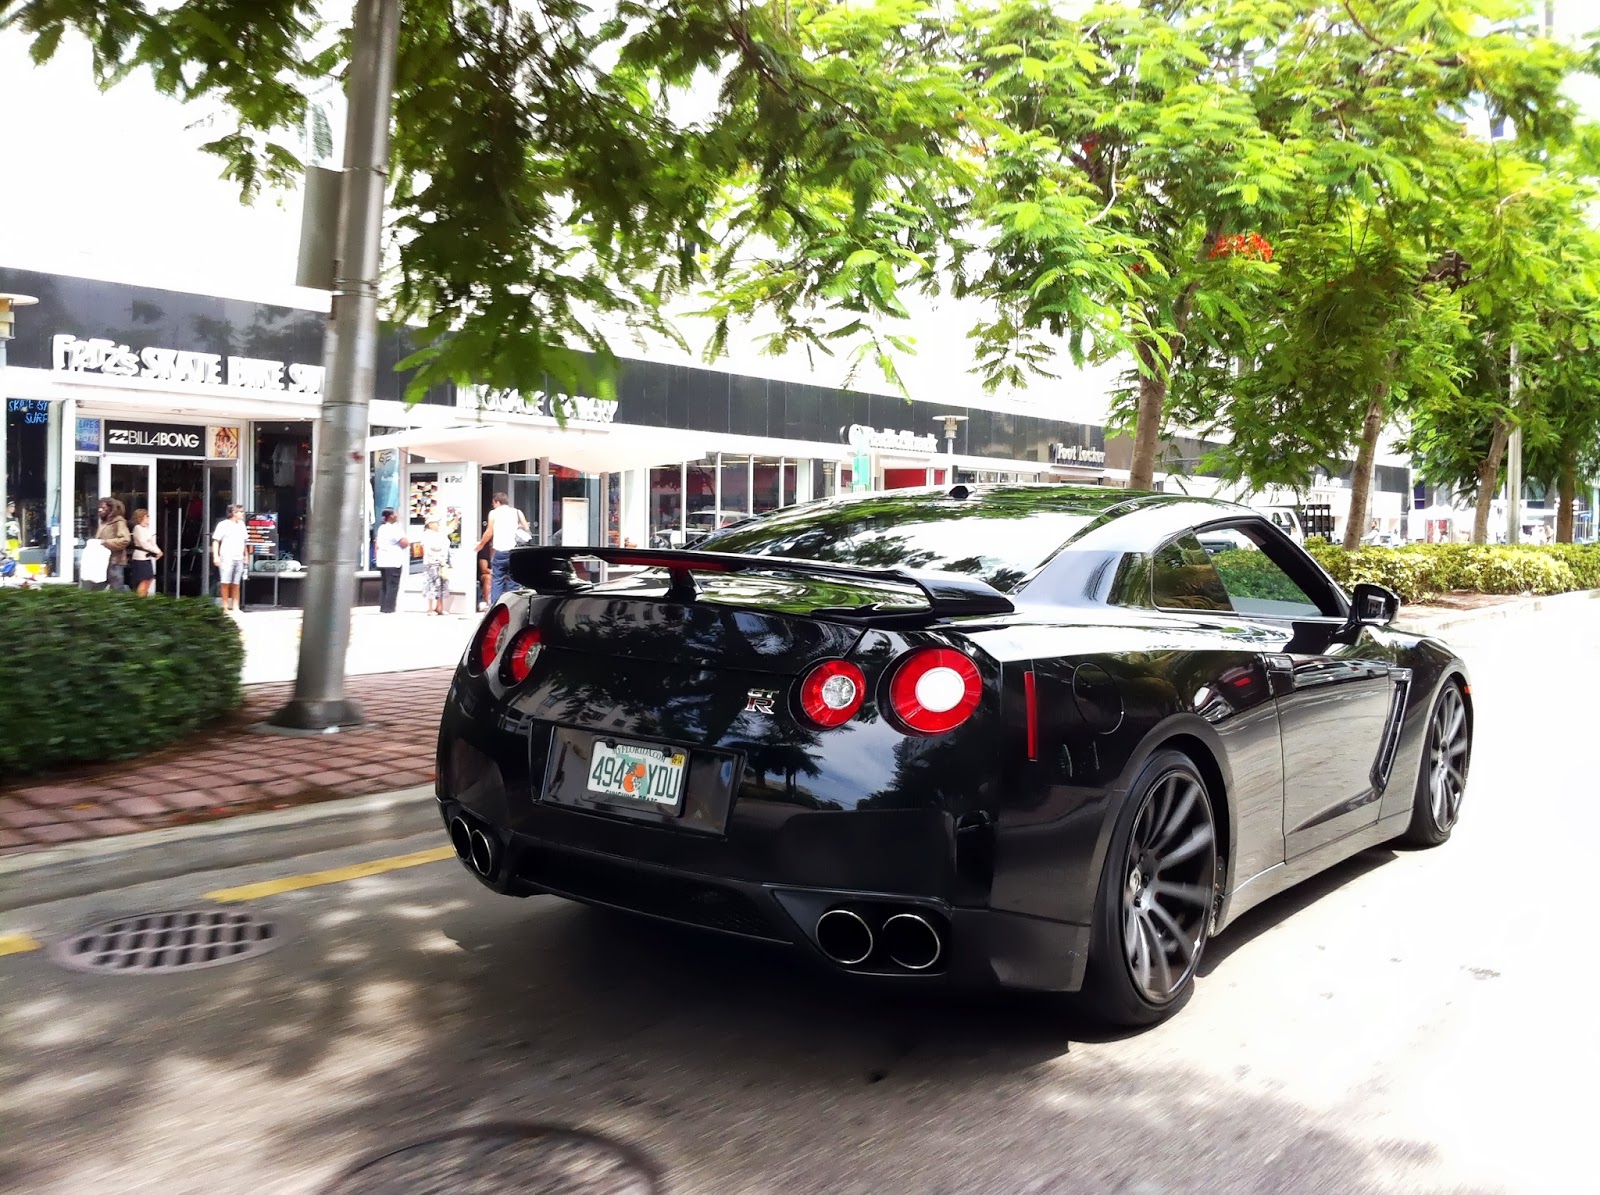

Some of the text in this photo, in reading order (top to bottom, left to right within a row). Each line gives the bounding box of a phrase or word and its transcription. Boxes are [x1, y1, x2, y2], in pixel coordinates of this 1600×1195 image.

[141, 347, 222, 385] SKATE
[228, 356, 284, 390] BIKE
[8, 399, 34, 412] SKAE
[128, 430, 200, 448] BILLABONG
[591, 755, 626, 790] 494
